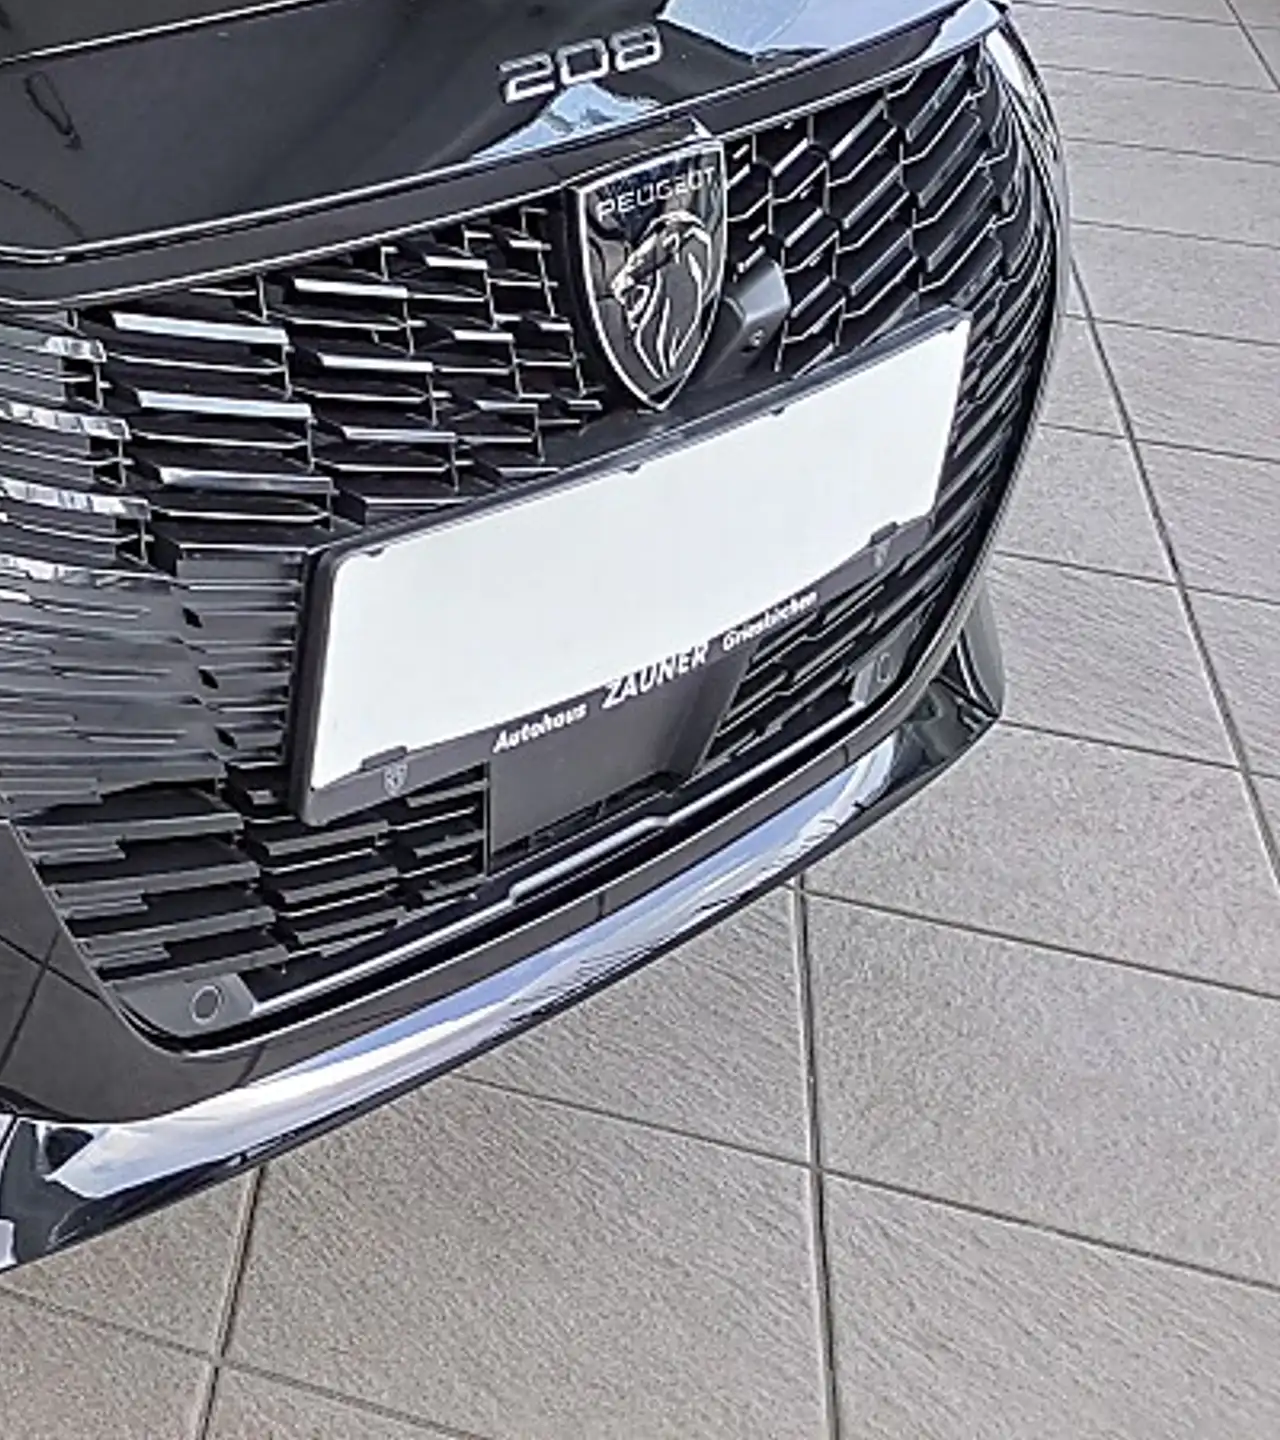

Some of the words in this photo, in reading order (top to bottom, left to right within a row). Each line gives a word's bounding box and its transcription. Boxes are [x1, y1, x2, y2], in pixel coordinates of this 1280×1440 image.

[498, 23, 664, 104] 208
[595, 165, 717, 224] PEUGEOT
[492, 702, 588, 754] Autohaus
[600, 640, 710, 711] ZAUNER
